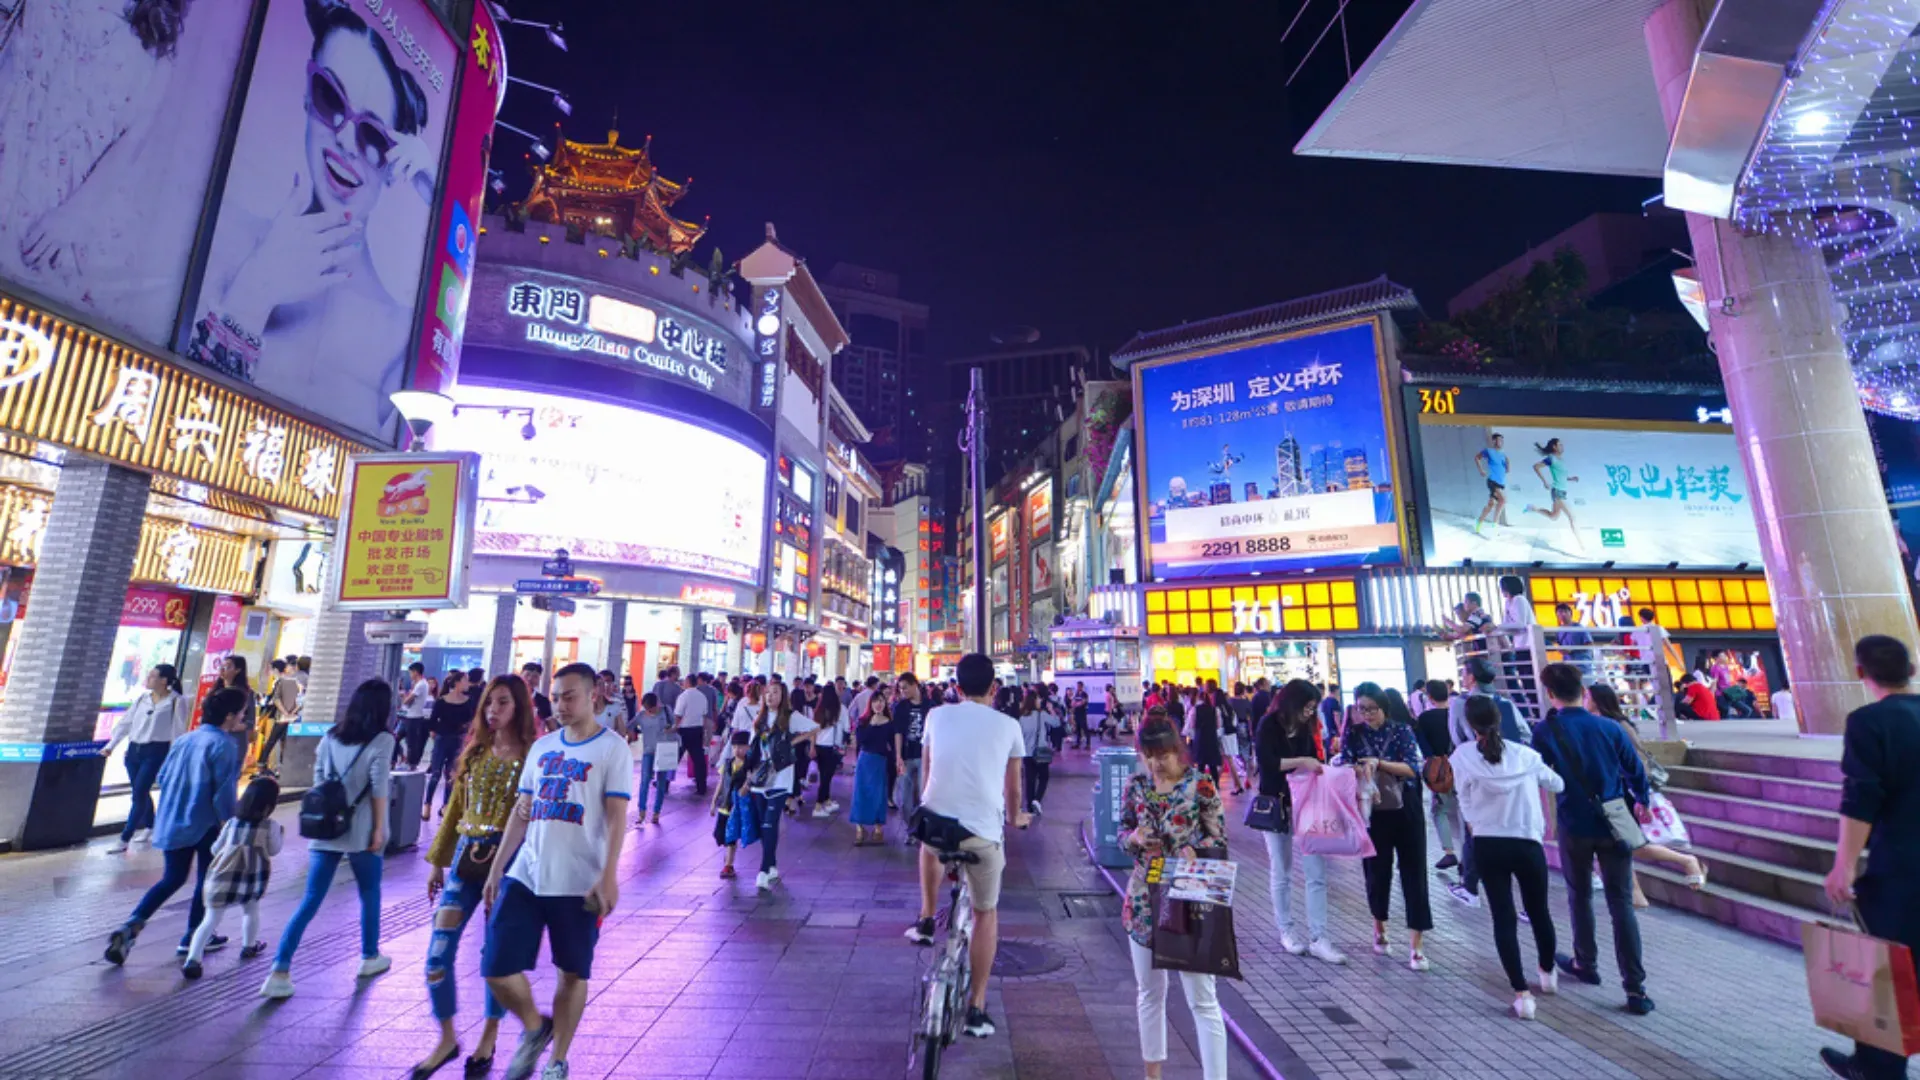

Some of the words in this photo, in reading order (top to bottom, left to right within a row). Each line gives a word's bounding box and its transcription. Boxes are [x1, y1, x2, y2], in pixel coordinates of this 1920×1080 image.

[634, 346, 686, 375] Centre
[689, 364, 715, 390] City
[1170, 382, 1236, 412] 为深圳
[1247, 363, 1343, 398] 定义中环
[1604, 462, 1742, 503] 跑出轻爽
[357, 528, 444, 544] 中国专业服饰
[367, 545, 431, 560] 批发市场
[1202, 541, 1240, 557] 2291
[1245, 537, 1291, 553] 8888
[366, 563, 411, 576] 欢迎您
